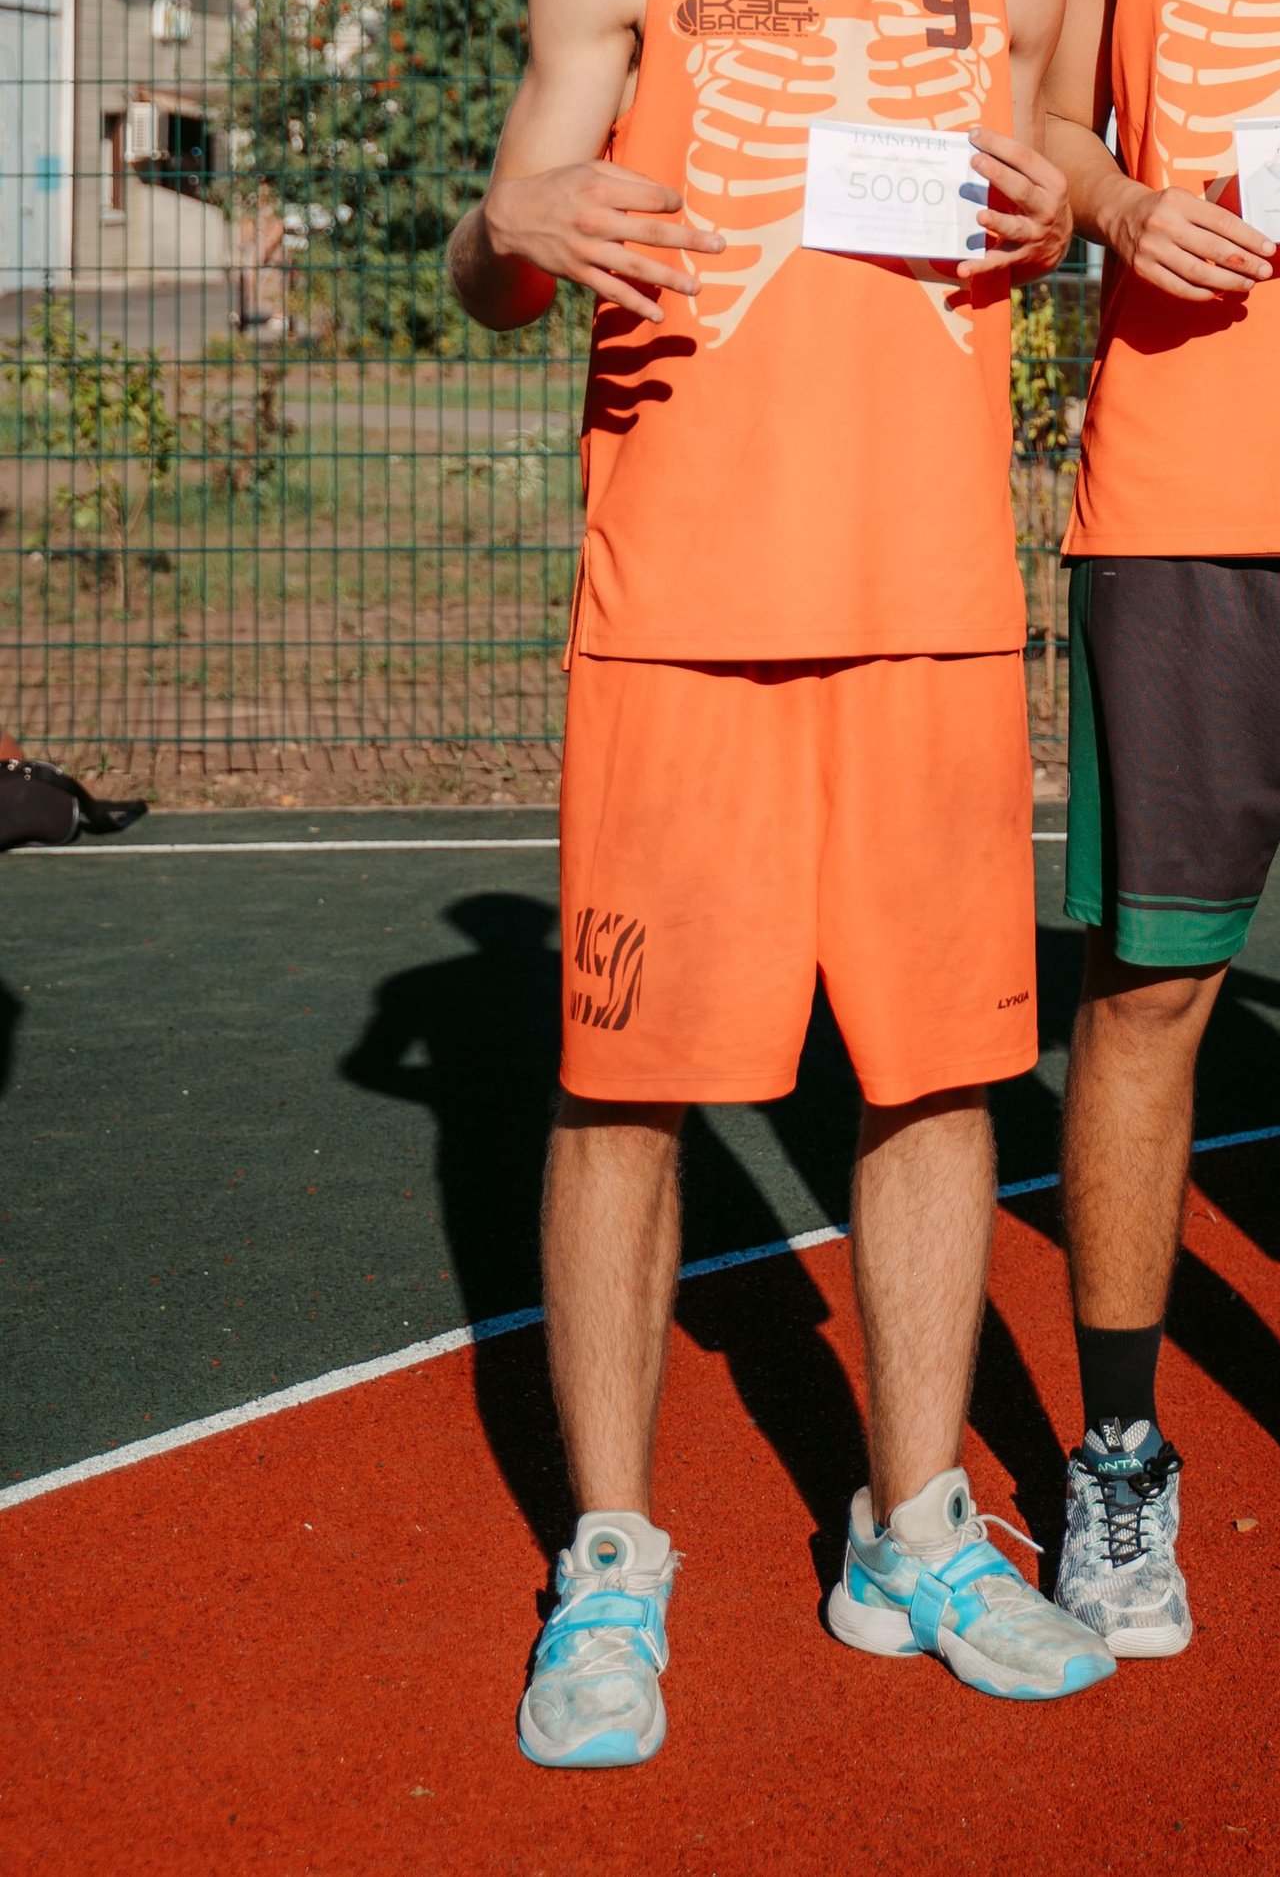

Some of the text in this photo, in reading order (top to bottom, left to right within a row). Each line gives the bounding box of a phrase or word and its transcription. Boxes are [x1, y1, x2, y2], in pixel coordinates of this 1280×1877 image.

[698, 14, 809, 33] БАСКЕТ
[851, 130, 947, 151] TOMSOYER
[847, 171, 945, 206] 5000
[997, 989, 1030, 1010] LYKIA
[1097, 1458, 1143, 1473] ANTA
